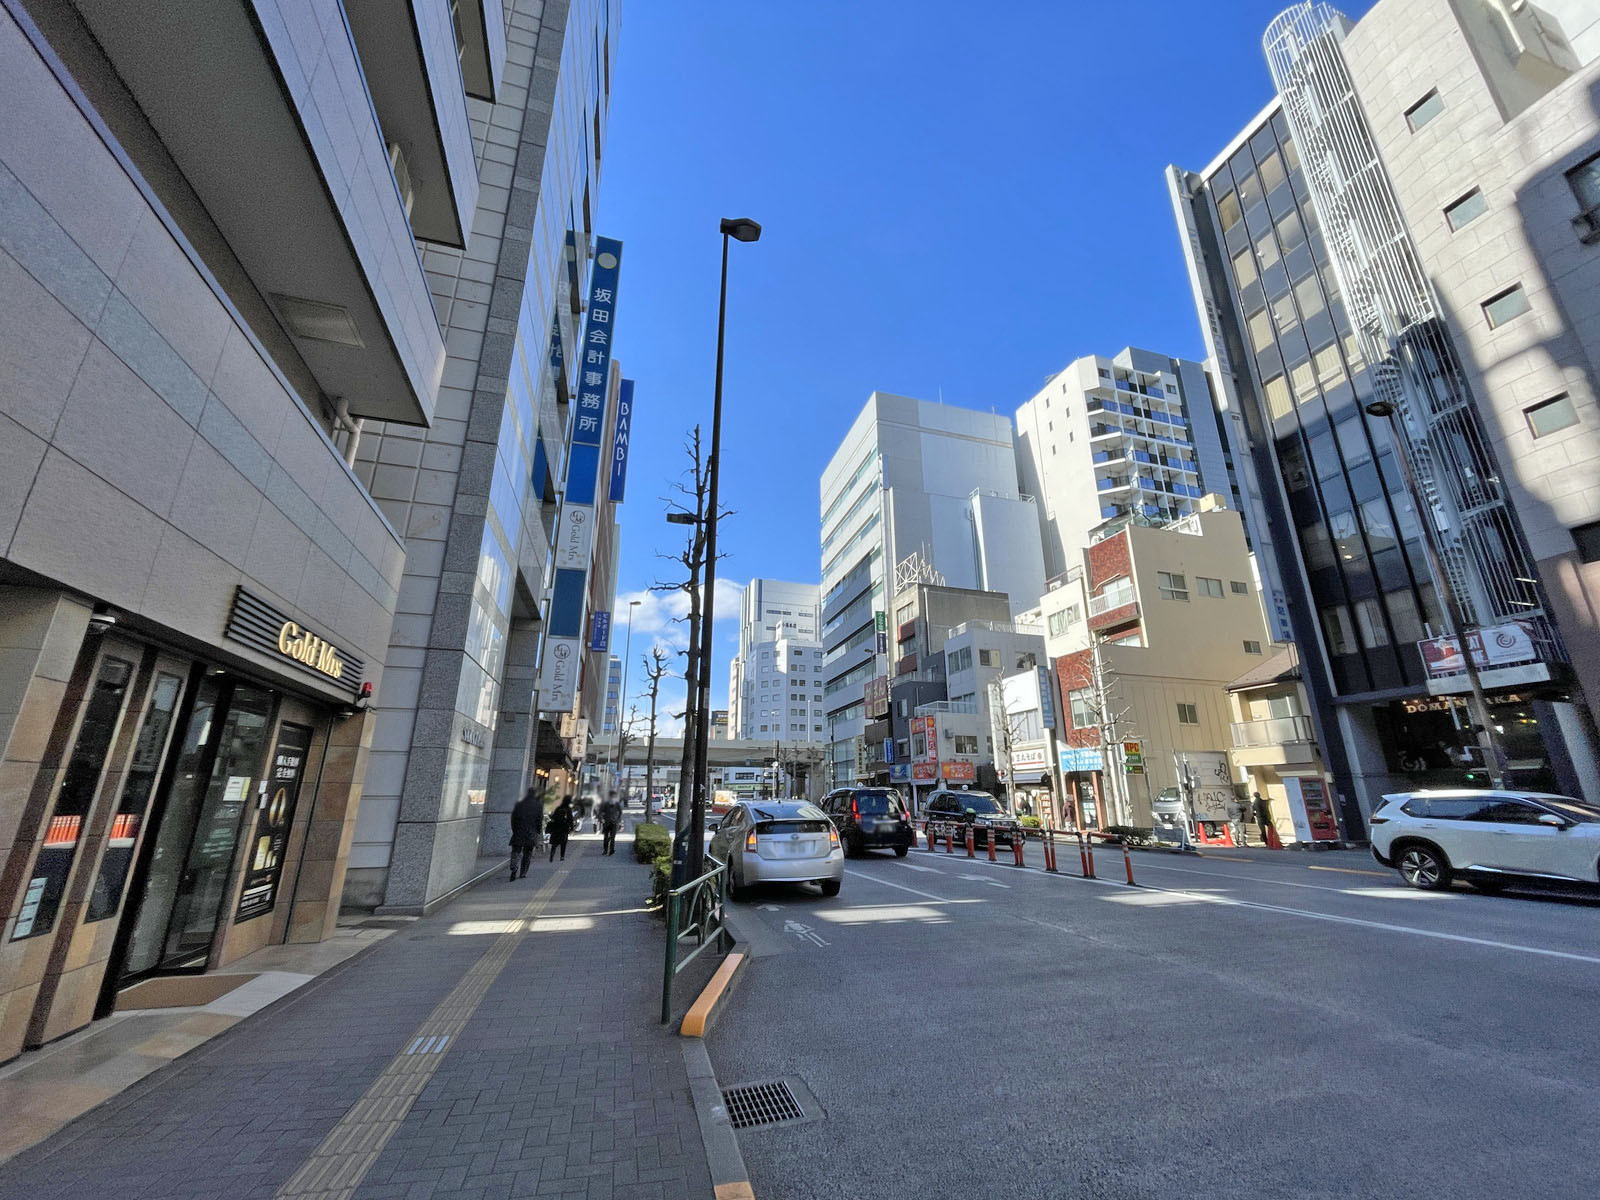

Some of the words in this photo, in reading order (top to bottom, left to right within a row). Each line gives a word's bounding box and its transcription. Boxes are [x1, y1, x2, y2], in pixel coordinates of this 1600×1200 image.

[578, 287, 612, 433] 坂田会計事務所
[615, 402, 629, 476] BAMBI
[570, 524, 580, 544] Gold
[278, 621, 320, 667] Gold
[316, 640, 344, 679] Mrs
[554, 660, 566, 681] Gold
